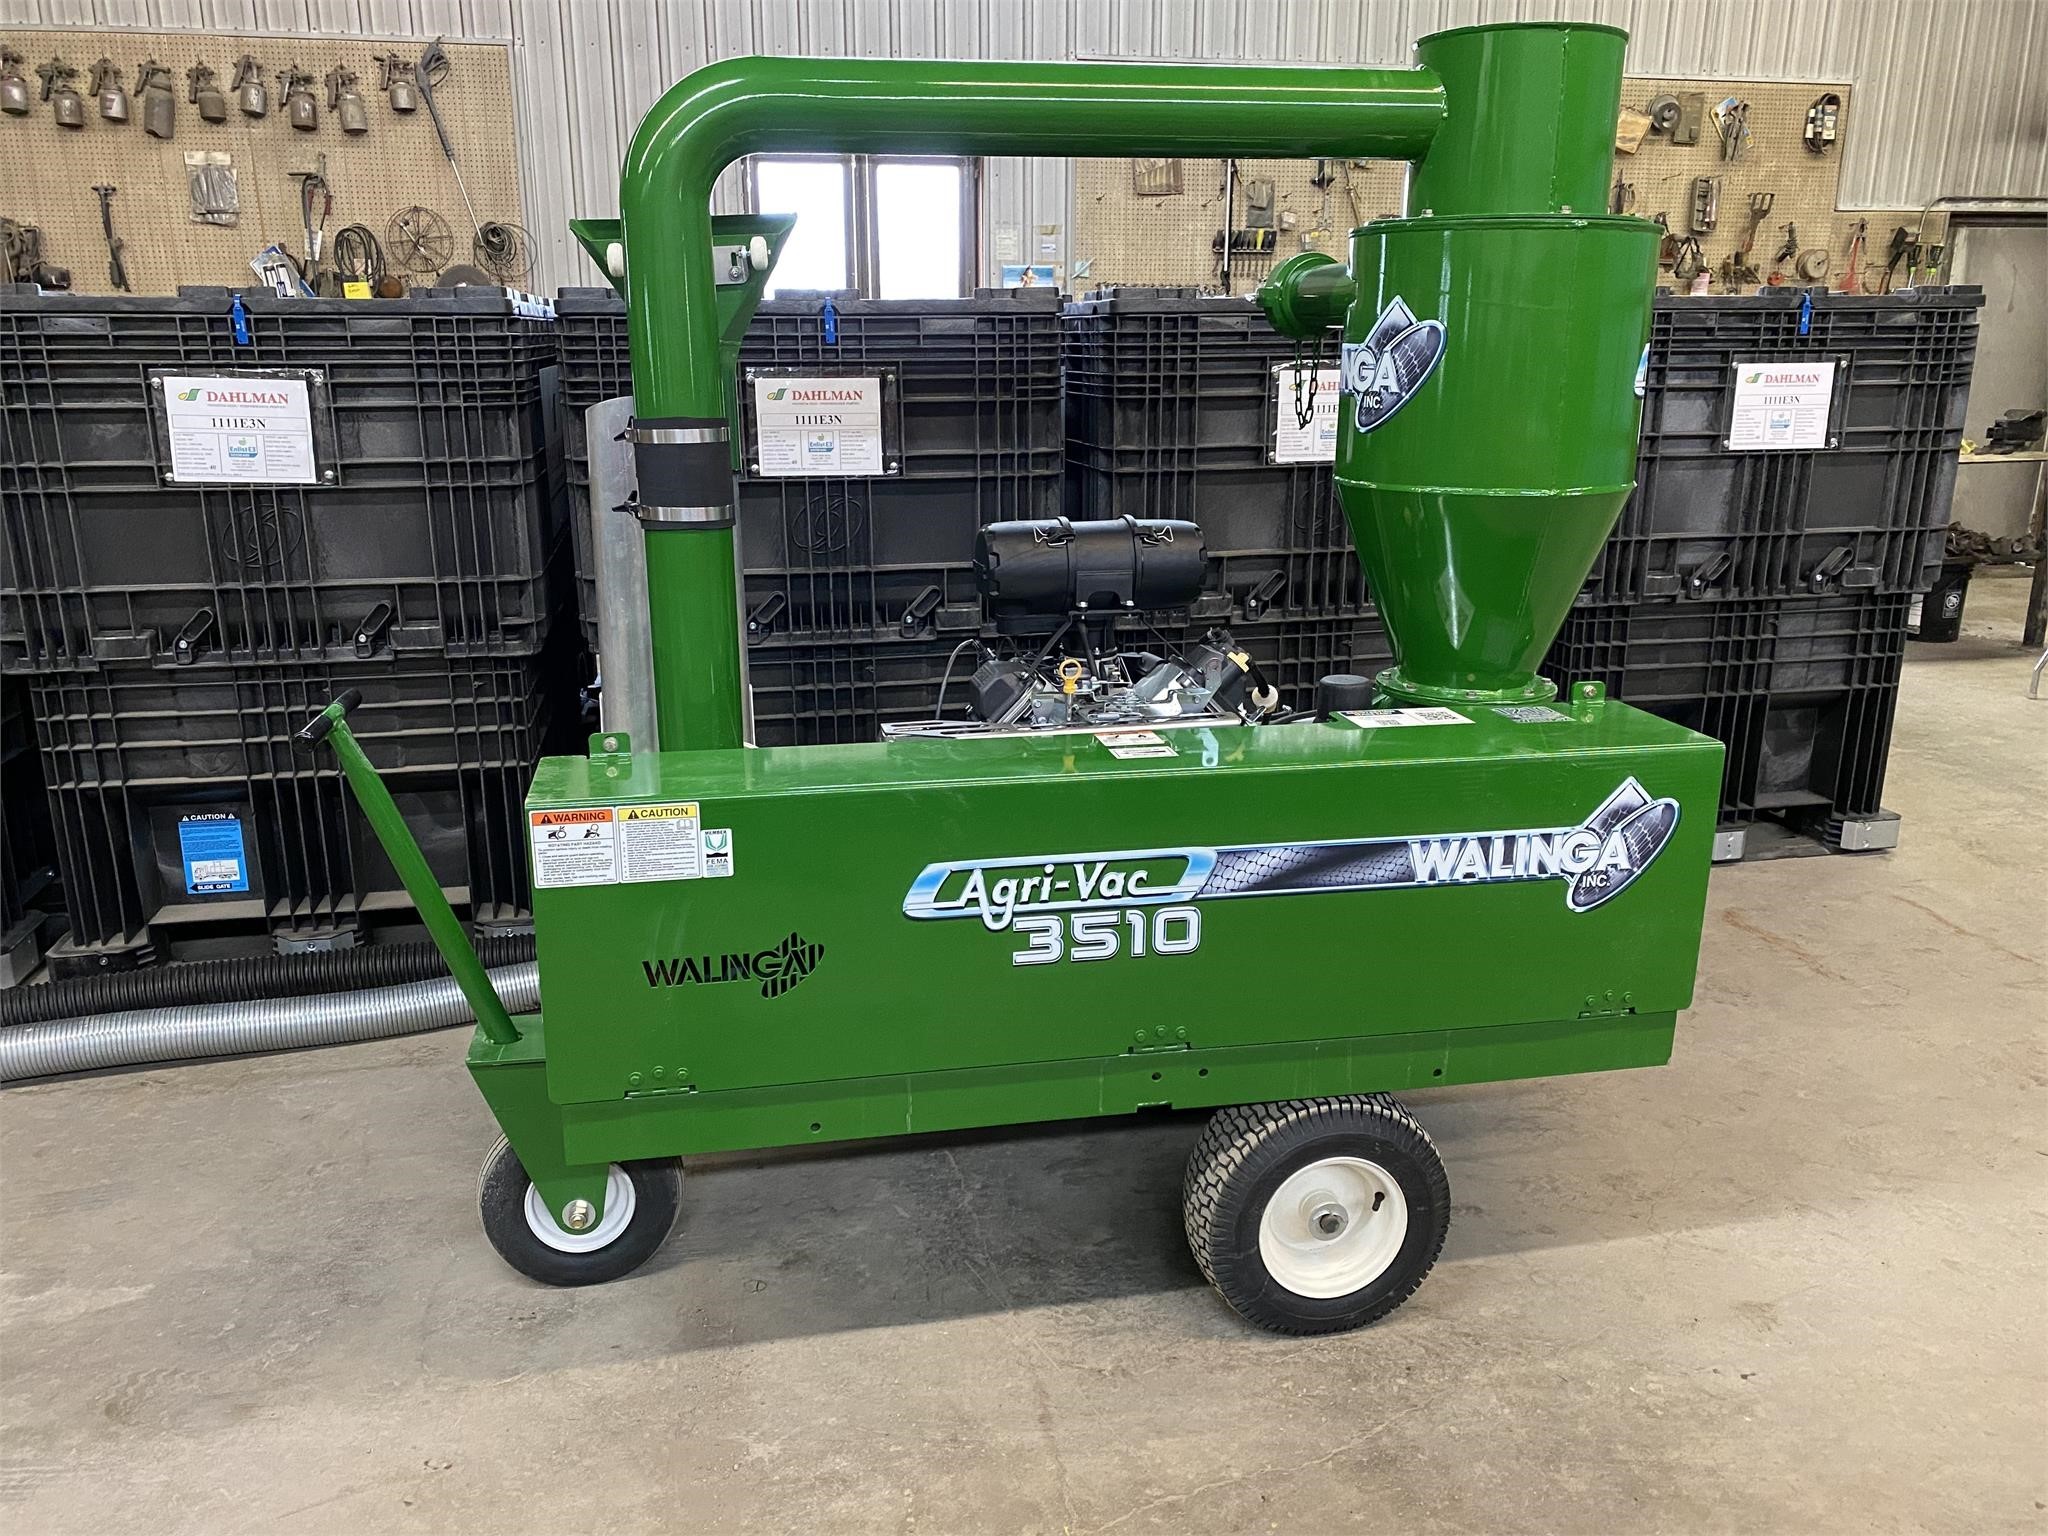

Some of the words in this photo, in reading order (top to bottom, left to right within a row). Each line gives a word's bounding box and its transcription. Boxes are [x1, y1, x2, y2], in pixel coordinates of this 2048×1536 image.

[1342, 348, 1401, 394] NGA
[1765, 374, 1820, 384] DAHLMAN
[207, 391, 289, 404] DAHLMAN
[792, 390, 863, 401] DAHLMAN
[1764, 395, 1800, 405] 1111E3N
[1363, 396, 1383, 409] INC.
[211, 417, 267, 429] 1111E3N
[795, 415, 842, 425] 1111E3N
[190, 813, 226, 821] CAUTION
[553, 811, 606, 823] WARNING
[640, 807, 688, 818] CAUTION
[1408, 829, 1632, 883] WALINGA
[1582, 875, 1611, 888] INC.
[956, 862, 1149, 930] Agri-Vac
[1012, 905, 1202, 966] 3510
[641, 949, 810, 988] WALINGA
